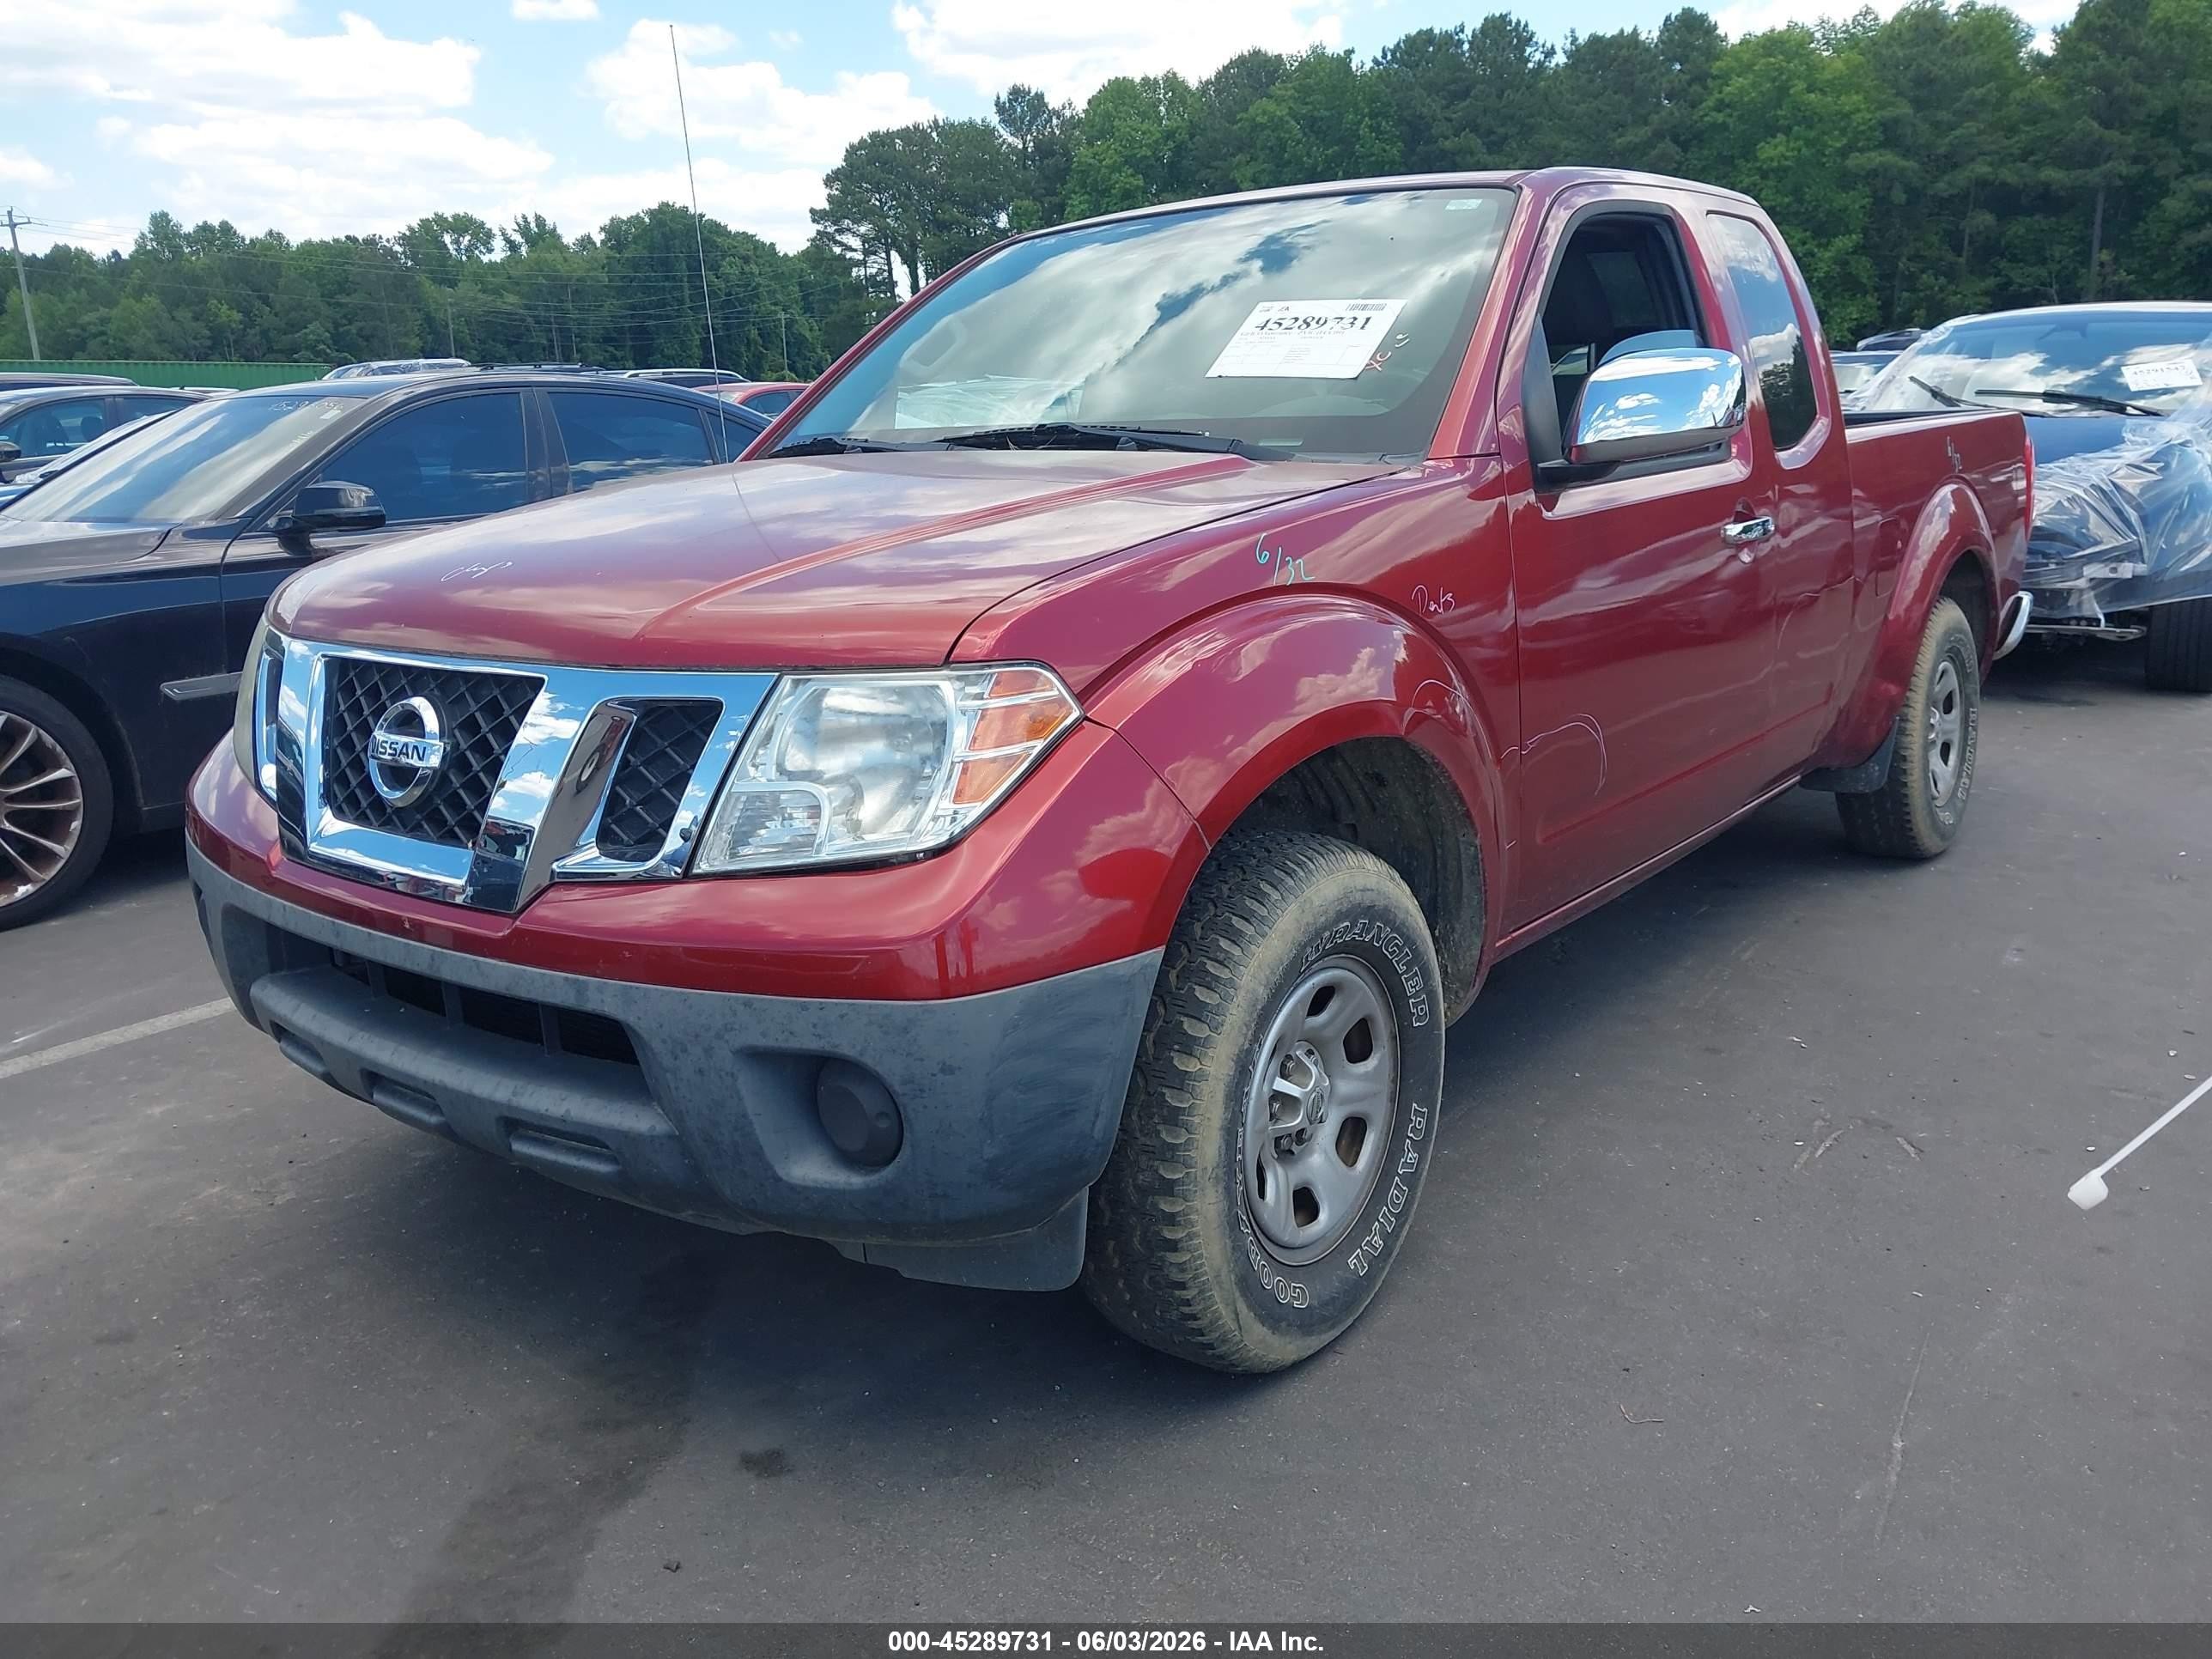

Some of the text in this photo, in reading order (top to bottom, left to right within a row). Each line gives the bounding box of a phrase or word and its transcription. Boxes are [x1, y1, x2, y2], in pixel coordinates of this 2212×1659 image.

[1255, 315, 1372, 331] 45289731
[370, 735, 427, 762] NISSAN
[1300, 920, 1430, 1027] WRANGLER
[1347, 1103, 1428, 1277] RADIAL
